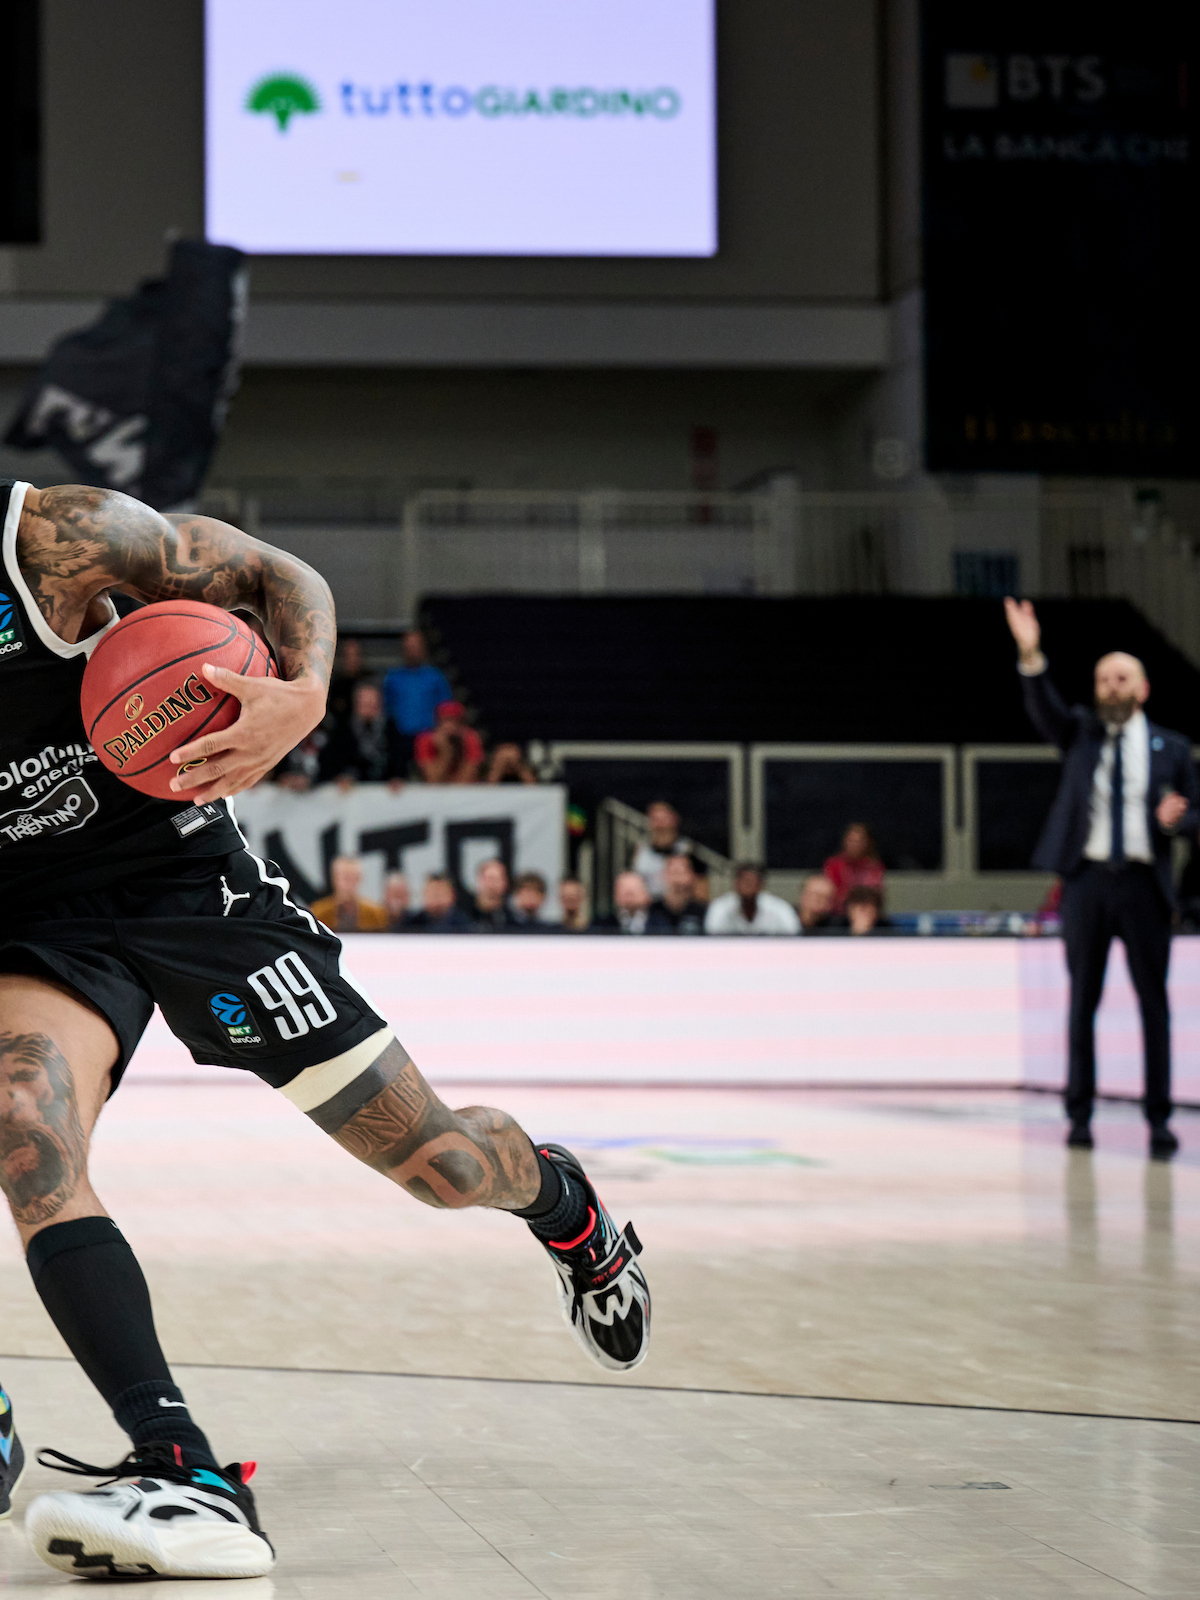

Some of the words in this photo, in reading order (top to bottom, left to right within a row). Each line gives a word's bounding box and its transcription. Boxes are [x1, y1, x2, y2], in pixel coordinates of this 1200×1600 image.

[1004, 52, 1108, 102] BTS
[103, 672, 215, 769] SPALDING
[0, 794, 81, 841] TRENTINO
[203, 805, 216, 815] M
[247, 951, 338, 1040] 99
[227, 1026, 252, 1036] BKT
[230, 1035, 262, 1044] EuroCup
